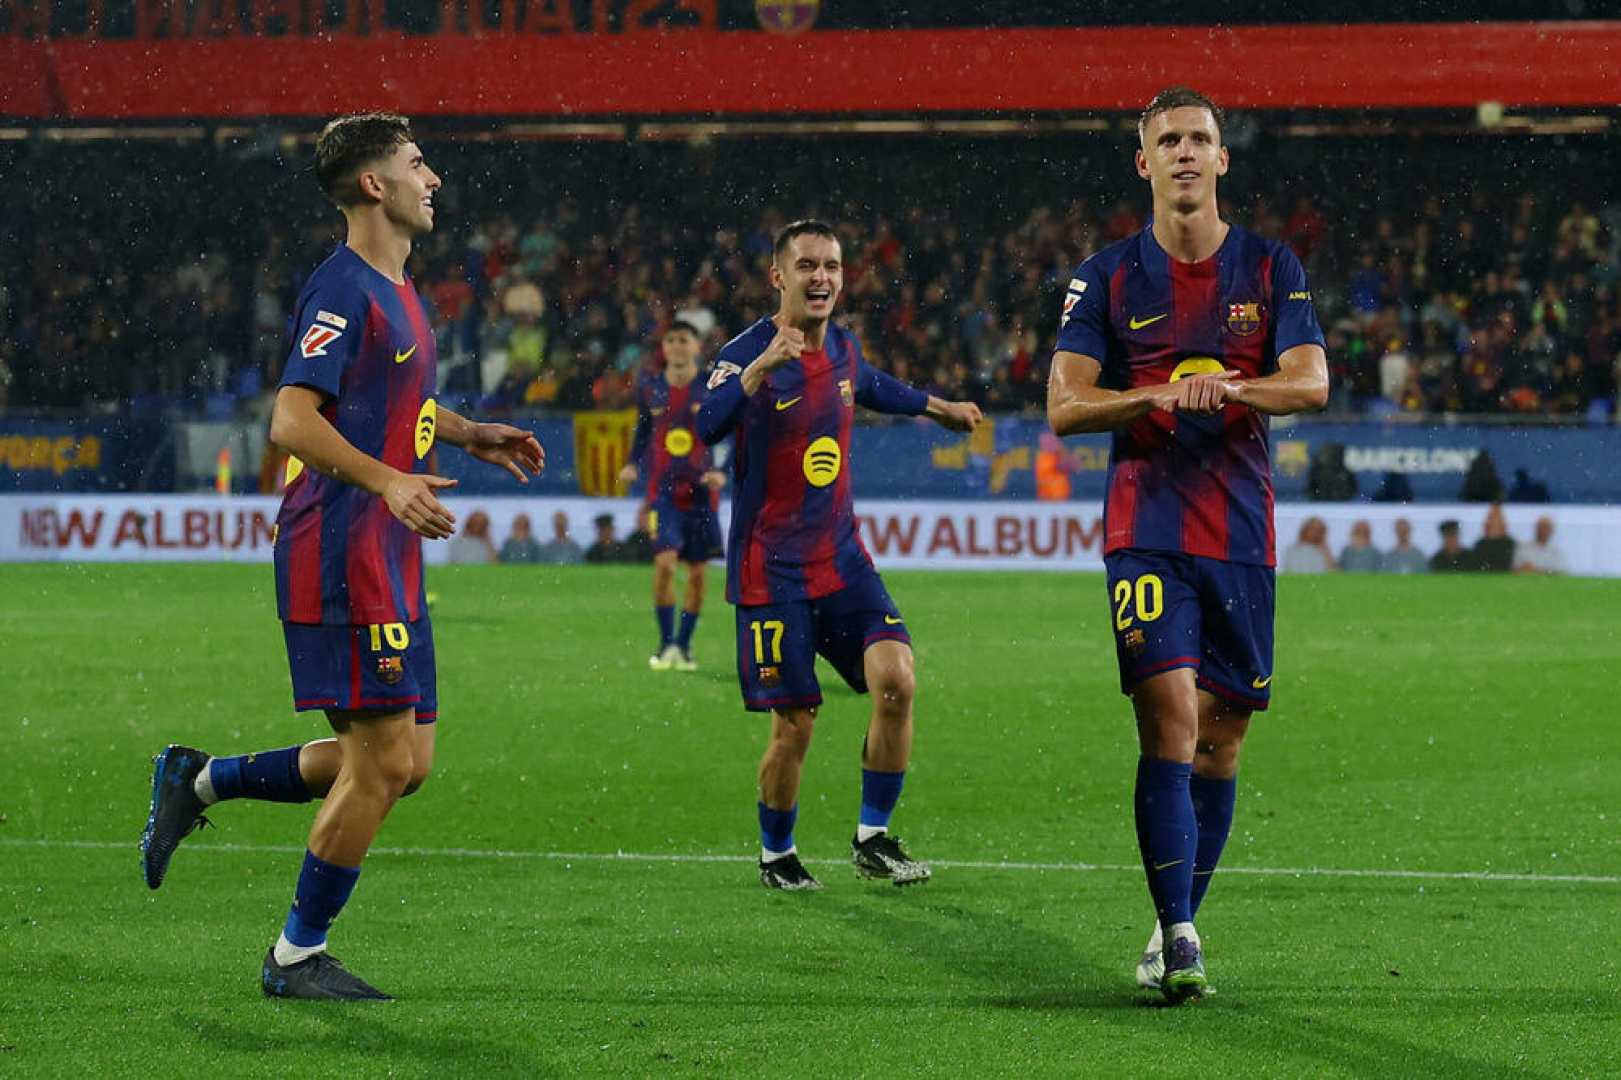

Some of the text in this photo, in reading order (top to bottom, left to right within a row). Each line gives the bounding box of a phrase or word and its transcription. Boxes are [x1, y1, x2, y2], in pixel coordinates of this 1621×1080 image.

[19, 507, 104, 547] NEW
[928, 515, 1104, 557] ALBUM
[1115, 574, 1163, 631] 20
[750, 620, 784, 663] 17
